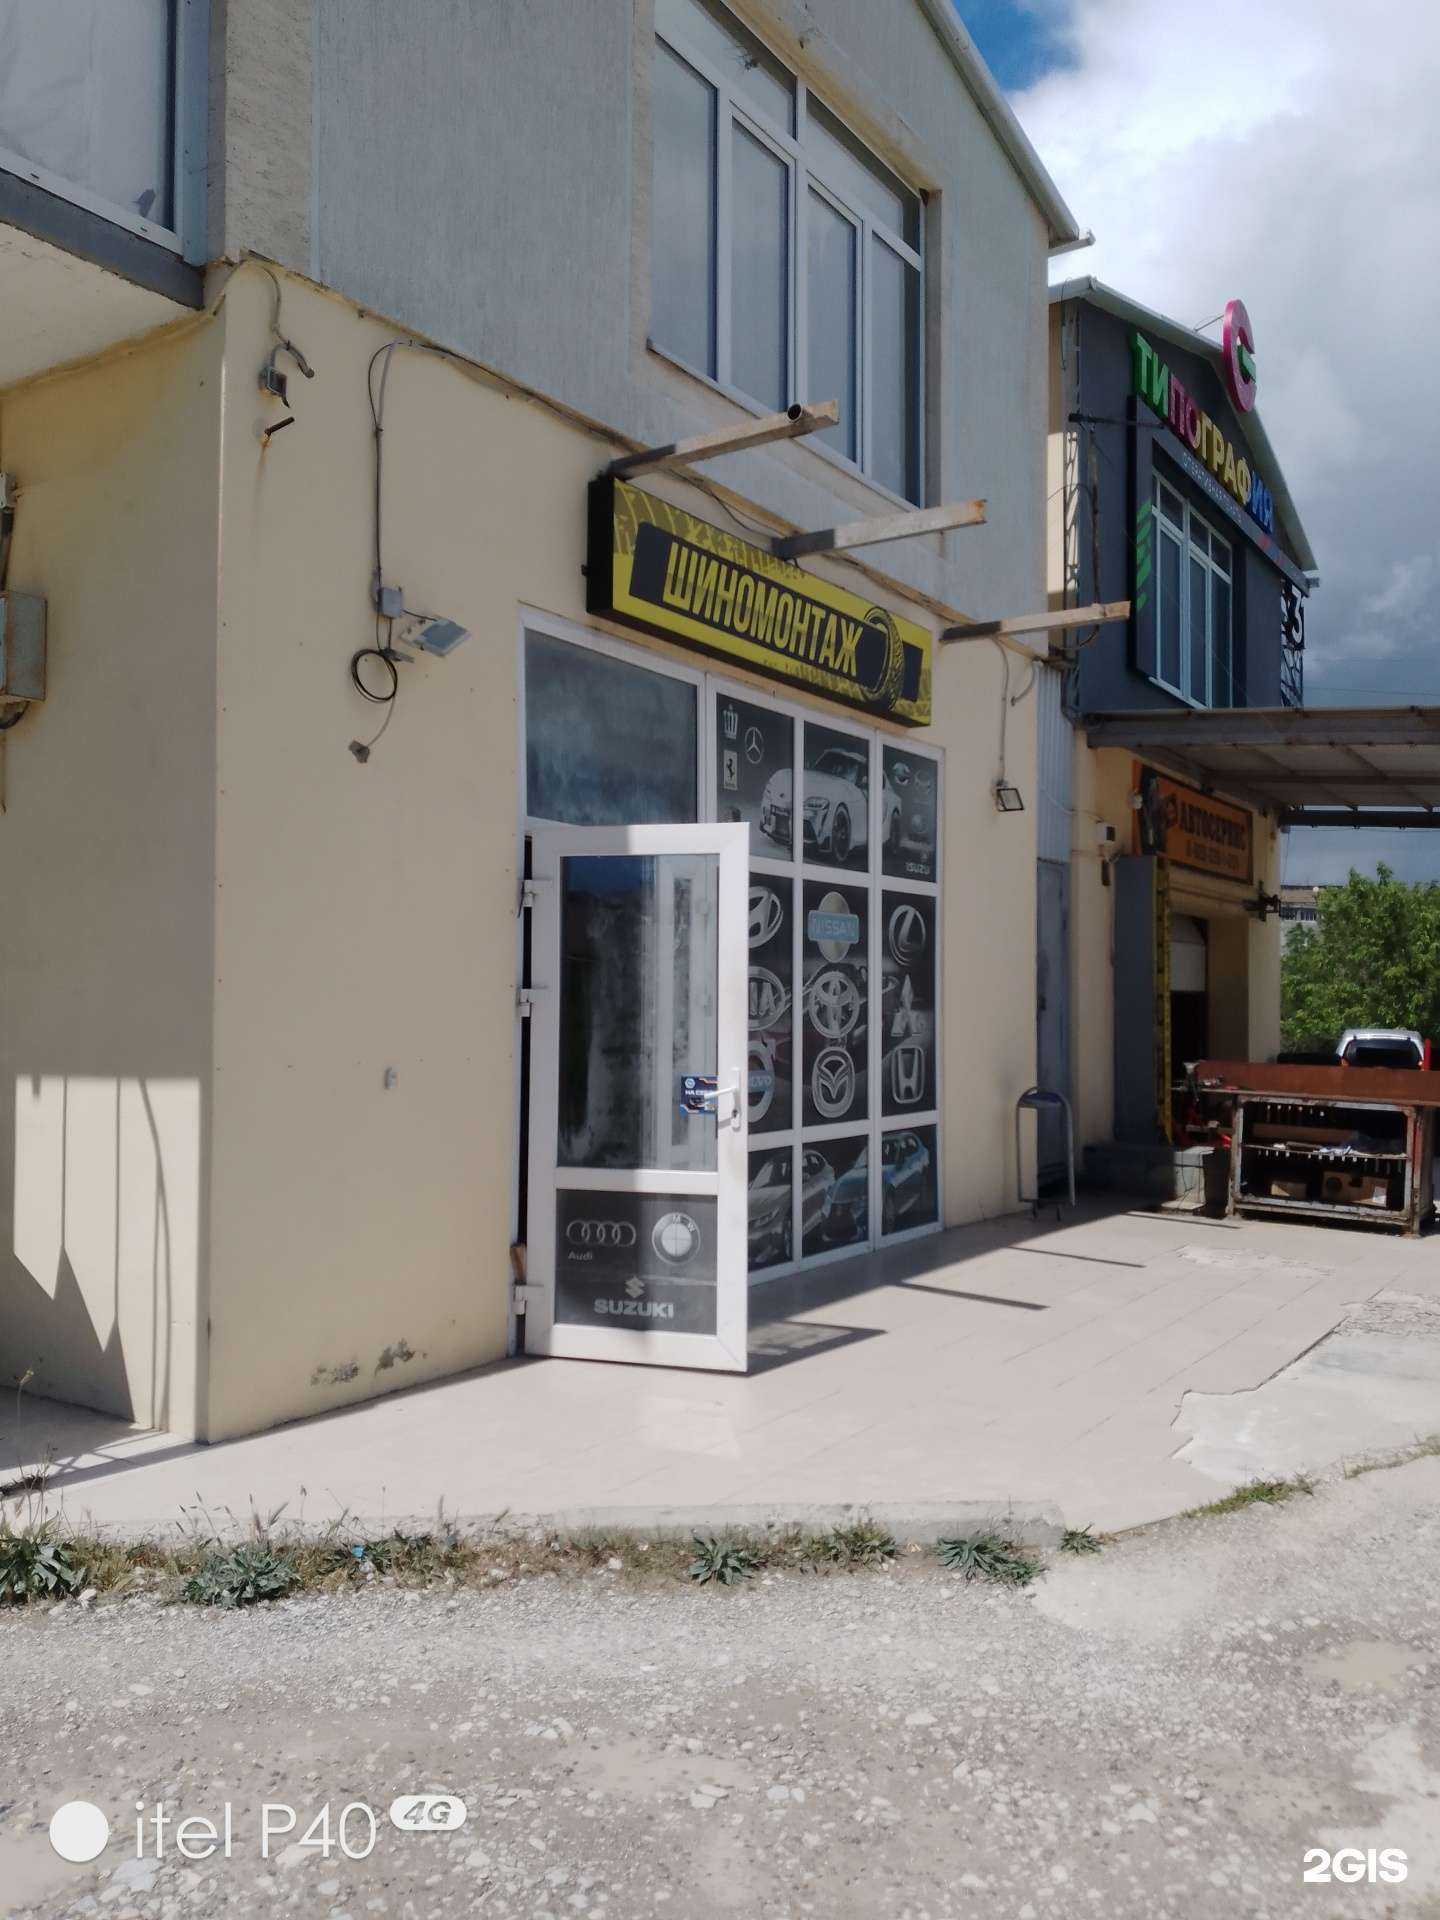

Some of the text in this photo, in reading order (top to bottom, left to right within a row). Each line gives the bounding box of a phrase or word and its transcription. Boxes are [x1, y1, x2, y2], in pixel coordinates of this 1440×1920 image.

[1133, 332, 1274, 535] ТИПОГРАФИЯ
[662, 541, 864, 677] ШИНОМОНТАЖ
[811, 917, 858, 937] NISSAN
[567, 1250, 593, 1261] Audi
[594, 1298, 675, 1319] SUZUKI
